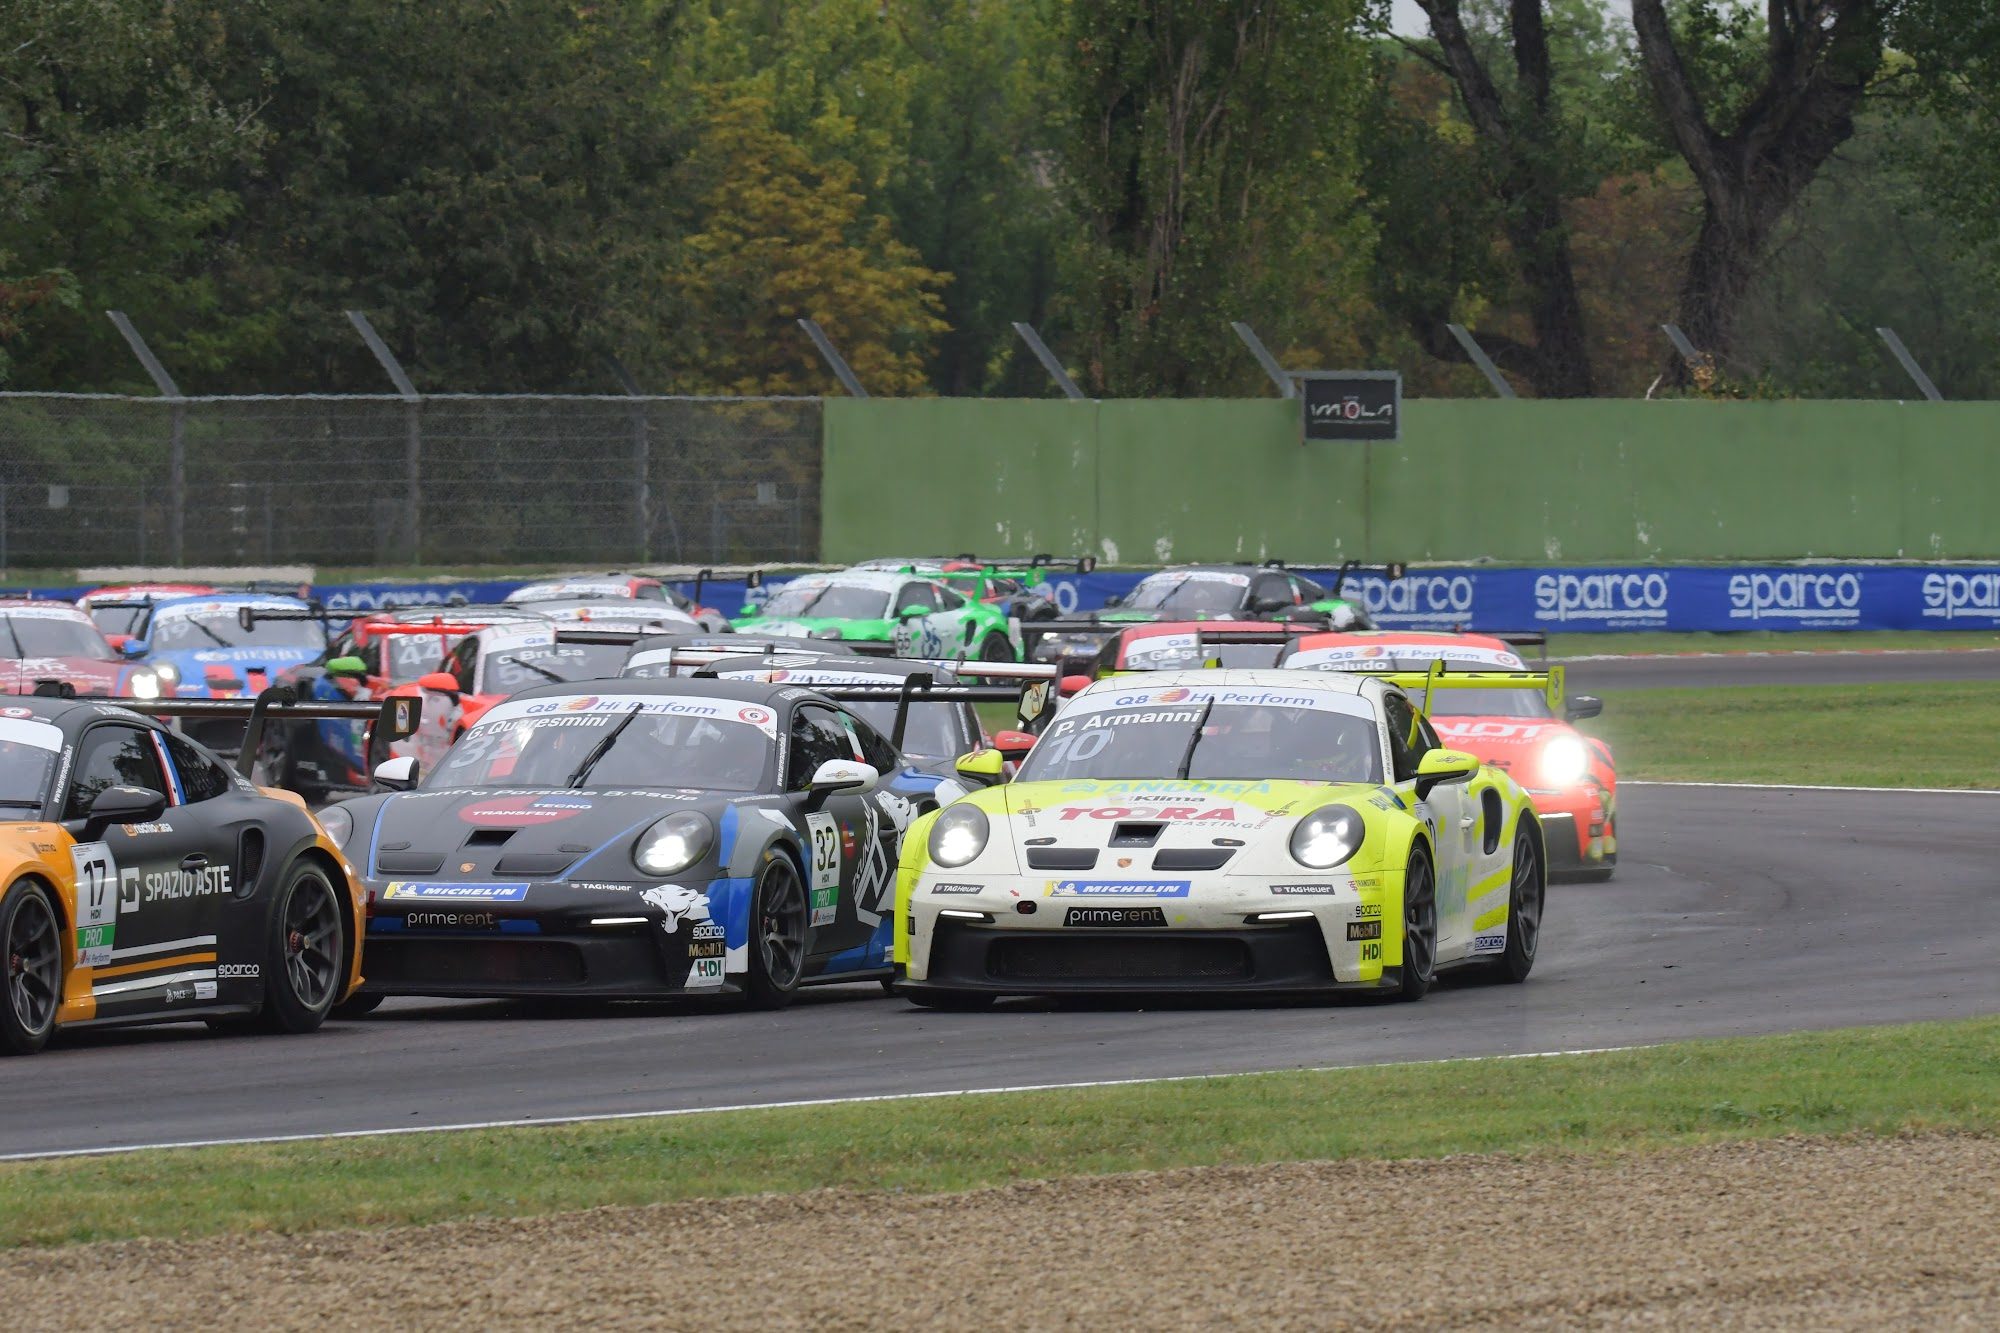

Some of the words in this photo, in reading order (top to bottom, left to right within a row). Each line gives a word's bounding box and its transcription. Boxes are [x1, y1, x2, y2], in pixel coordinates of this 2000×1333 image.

[1535, 574, 1668, 620] sparco
[1729, 573, 1860, 619] sparco
[526, 703, 560, 714] Q8
[595, 700, 622, 711] Hi
[626, 701, 717, 716] Perform
[1115, 694, 1150, 706] Q8
[1189, 692, 1216, 703] Hi
[1221, 692, 1315, 706] Perform
[1054, 721, 1076, 738] P.
[1081, 709, 1203, 732] Armanni
[1048, 729, 1113, 766] 10
[401, 789, 487, 799] Centro
[1058, 806, 1236, 821] TOORA
[815, 825, 837, 872] 32
[83, 859, 106, 907] 17
[145, 870, 194, 902] SPAZIO
[195, 865, 233, 896] ASTE
[421, 886, 518, 897] MICHELIN
[1082, 884, 1181, 894] MICHELIN
[816, 889, 831, 908] PRO
[406, 911, 494, 928] primerent
[1069, 906, 1161, 925] primerent
[1355, 904, 1382, 918] sparco
[83, 927, 103, 948] PRO
[692, 925, 725, 940] sparco
[1362, 942, 1382, 961] HDI
[1474, 936, 1505, 949] sparco
[217, 963, 260, 978] sparco
[697, 959, 722, 977] HDI
